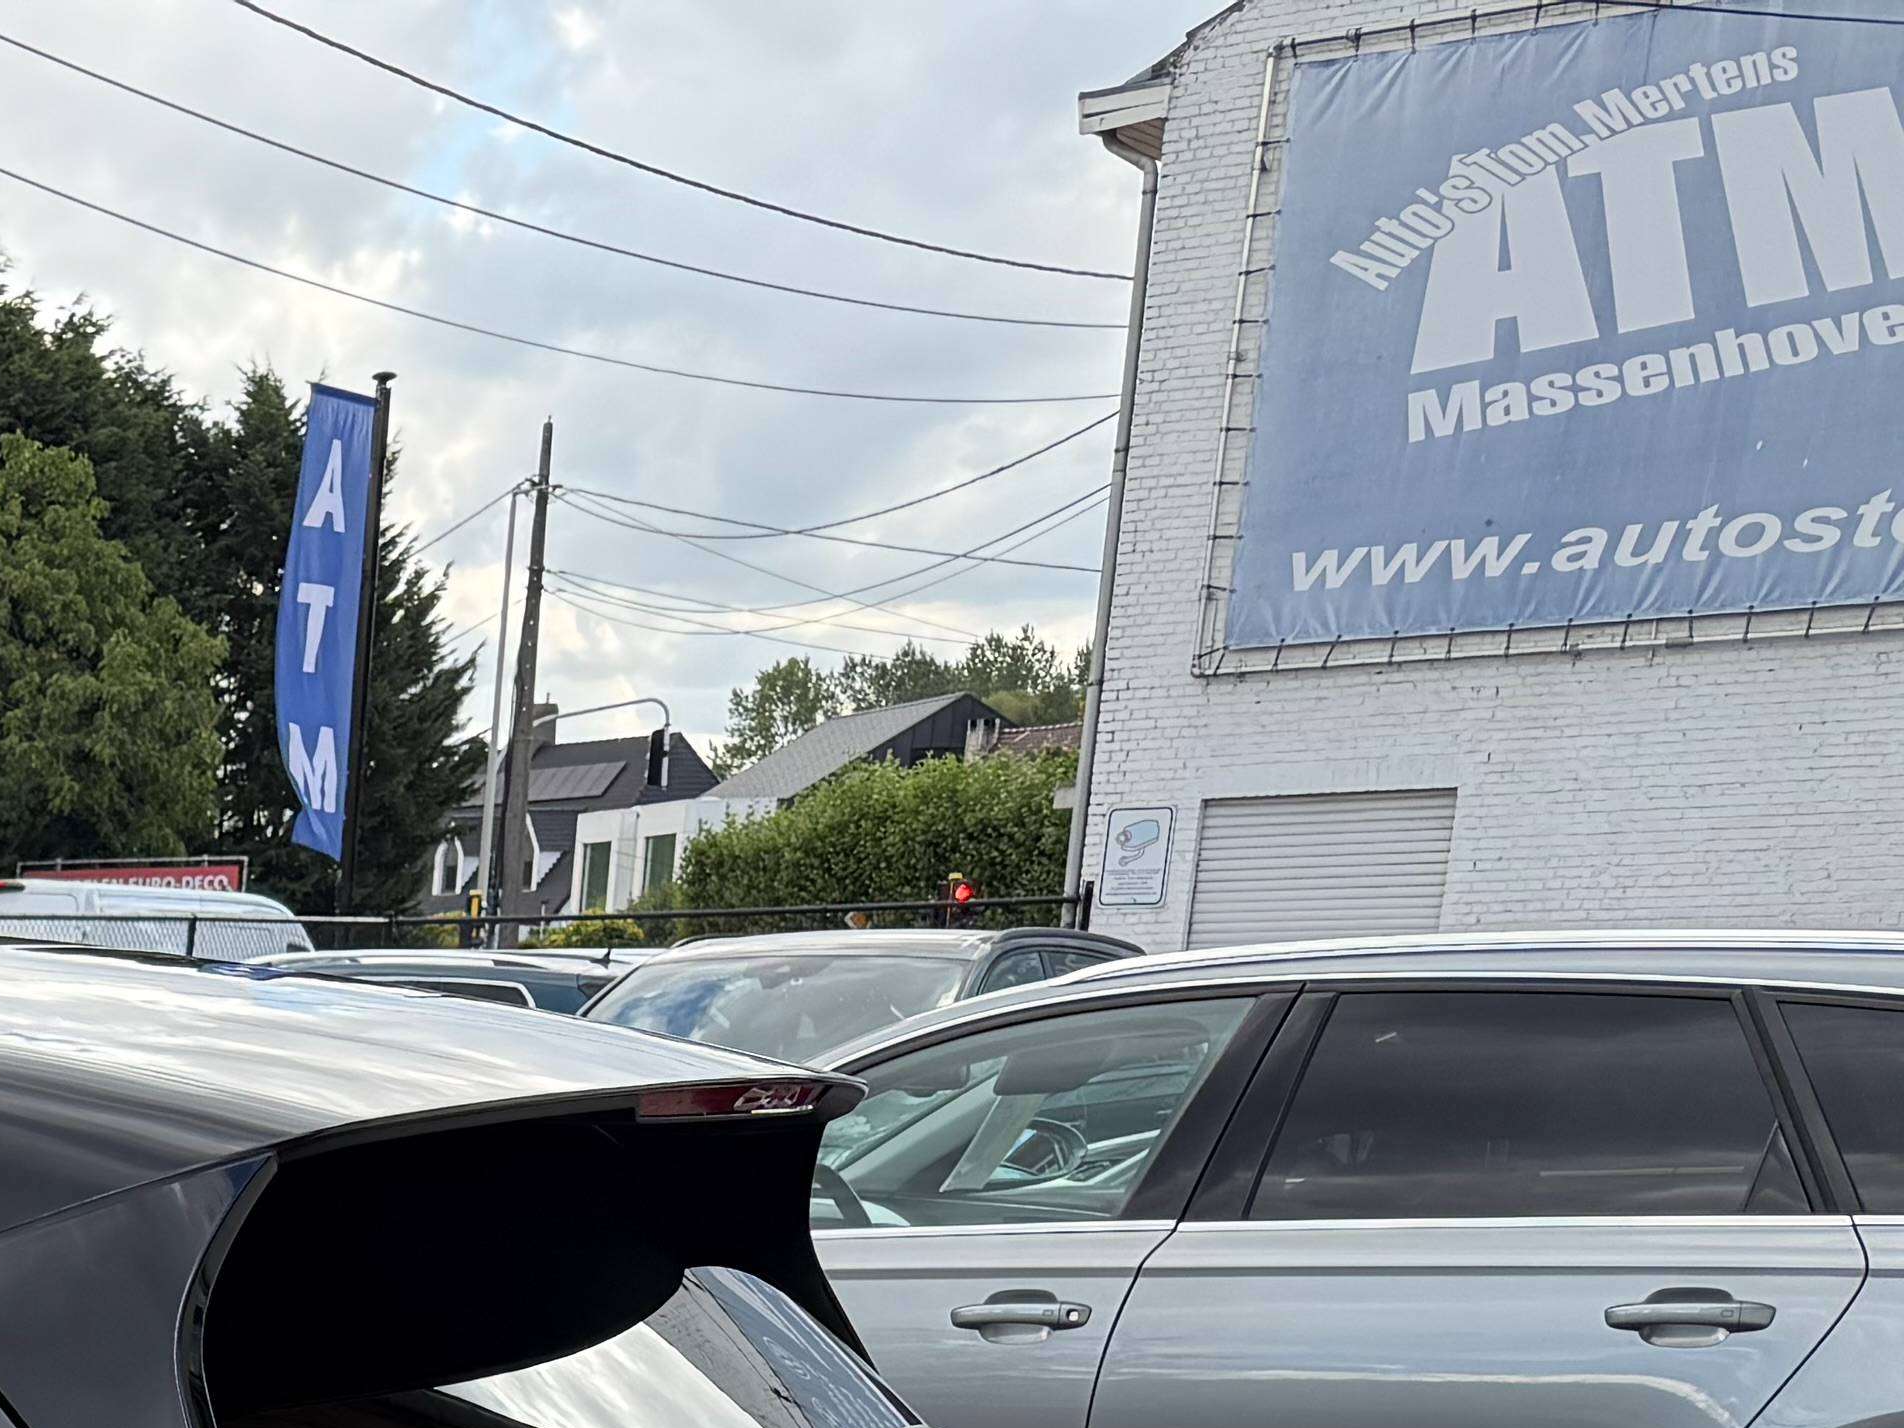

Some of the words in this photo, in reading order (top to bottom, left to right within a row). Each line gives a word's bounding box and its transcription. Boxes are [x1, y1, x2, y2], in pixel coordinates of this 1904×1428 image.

[1329, 174, 1493, 291] Auto's
[1462, 121, 1585, 186] Tom
[1573, 46, 1799, 140] Mertens
[1410, 86, 1904, 374] ATM
[289, 439, 345, 813] ATM
[1292, 488, 1904, 592] www.autost
